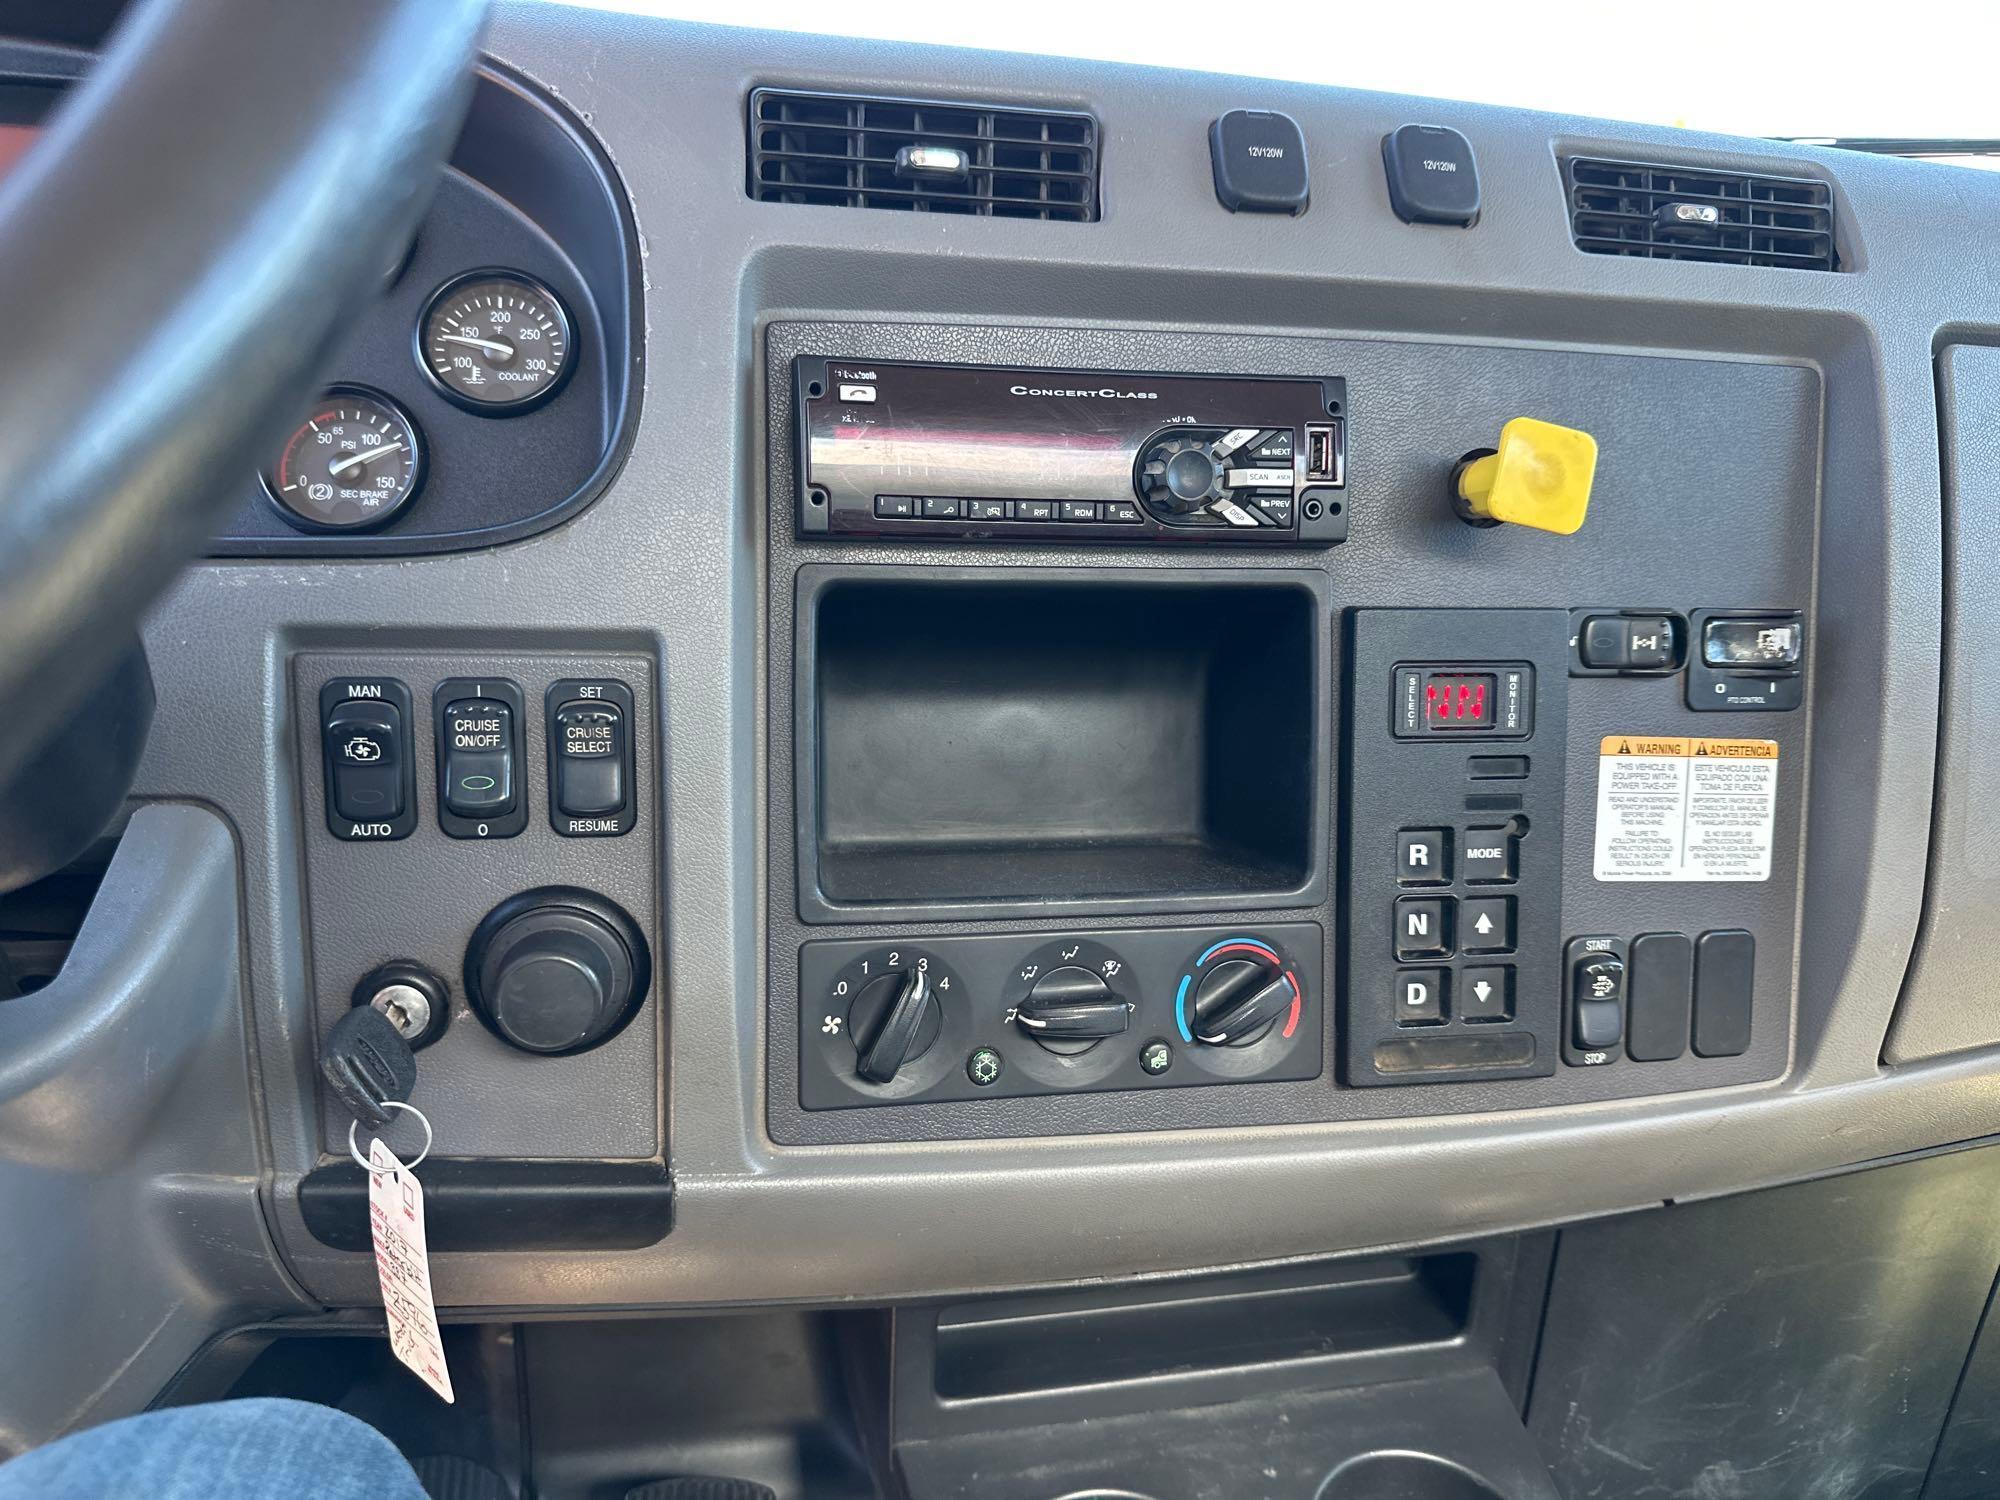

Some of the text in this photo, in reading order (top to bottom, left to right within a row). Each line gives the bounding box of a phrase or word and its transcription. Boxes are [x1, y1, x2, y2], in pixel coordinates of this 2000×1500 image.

[1248, 146, 1283, 159] 12V120W
[1423, 160, 1456, 173] 12V120W
[490, 311, 511, 323] 200
[460, 327, 479, 338] 150
[520, 329, 541, 340] 250
[453, 357, 472, 368] 100
[526, 359, 546, 370] 300
[499, 373, 539, 382] COOLANT
[333, 427, 343, 435] 65
[318, 433, 333, 444] 50
[361, 434, 381, 445] 100
[341, 441, 356, 450] PSI
[1271, 448, 1291, 456] NEXT
[300, 476, 307, 487] 0
[376, 477, 395, 489] 150
[340, 490, 388, 499] SEC BRAKE
[363, 498, 379, 506] AIR
[927, 499, 933, 507] 2
[1034, 509, 1049, 517] RPT
[1074, 509, 1093, 517] RDM
[1110, 505, 1134, 518] 6 ESC
[1229, 509, 1245, 521] DISP
[349, 686, 381, 698] MAN
[580, 686, 603, 698] SET
[1408, 677, 1417, 727] SELECT
[1507, 675, 1518, 728] MONITOR
[455, 720, 500, 732] CRUISE
[567, 727, 611, 739] CRUISE
[455, 735, 501, 747] ON/OFF
[567, 741, 612, 753] SELECT
[1636, 744, 1681, 755] WARNING
[1709, 745, 1771, 756] ADVERTENCIA
[1635, 763, 1666, 771] VEHICLE
[1612, 772, 1650, 780] EQUIPPED
[351, 824, 392, 836] AUTO
[569, 820, 619, 832] RESUME
[1409, 844, 1429, 866] R
[1467, 848, 1503, 859] MODE
[1408, 914, 1428, 935] N
[1585, 940, 1613, 950] START
[889, 952, 899, 966] 2
[918, 958, 928, 972] 3
[862, 961, 868, 974] 1
[837, 981, 848, 995] 0
[940, 976, 950, 990] 4
[1407, 983, 1427, 1005] D
[1584, 1053, 1606, 1064] STOP
